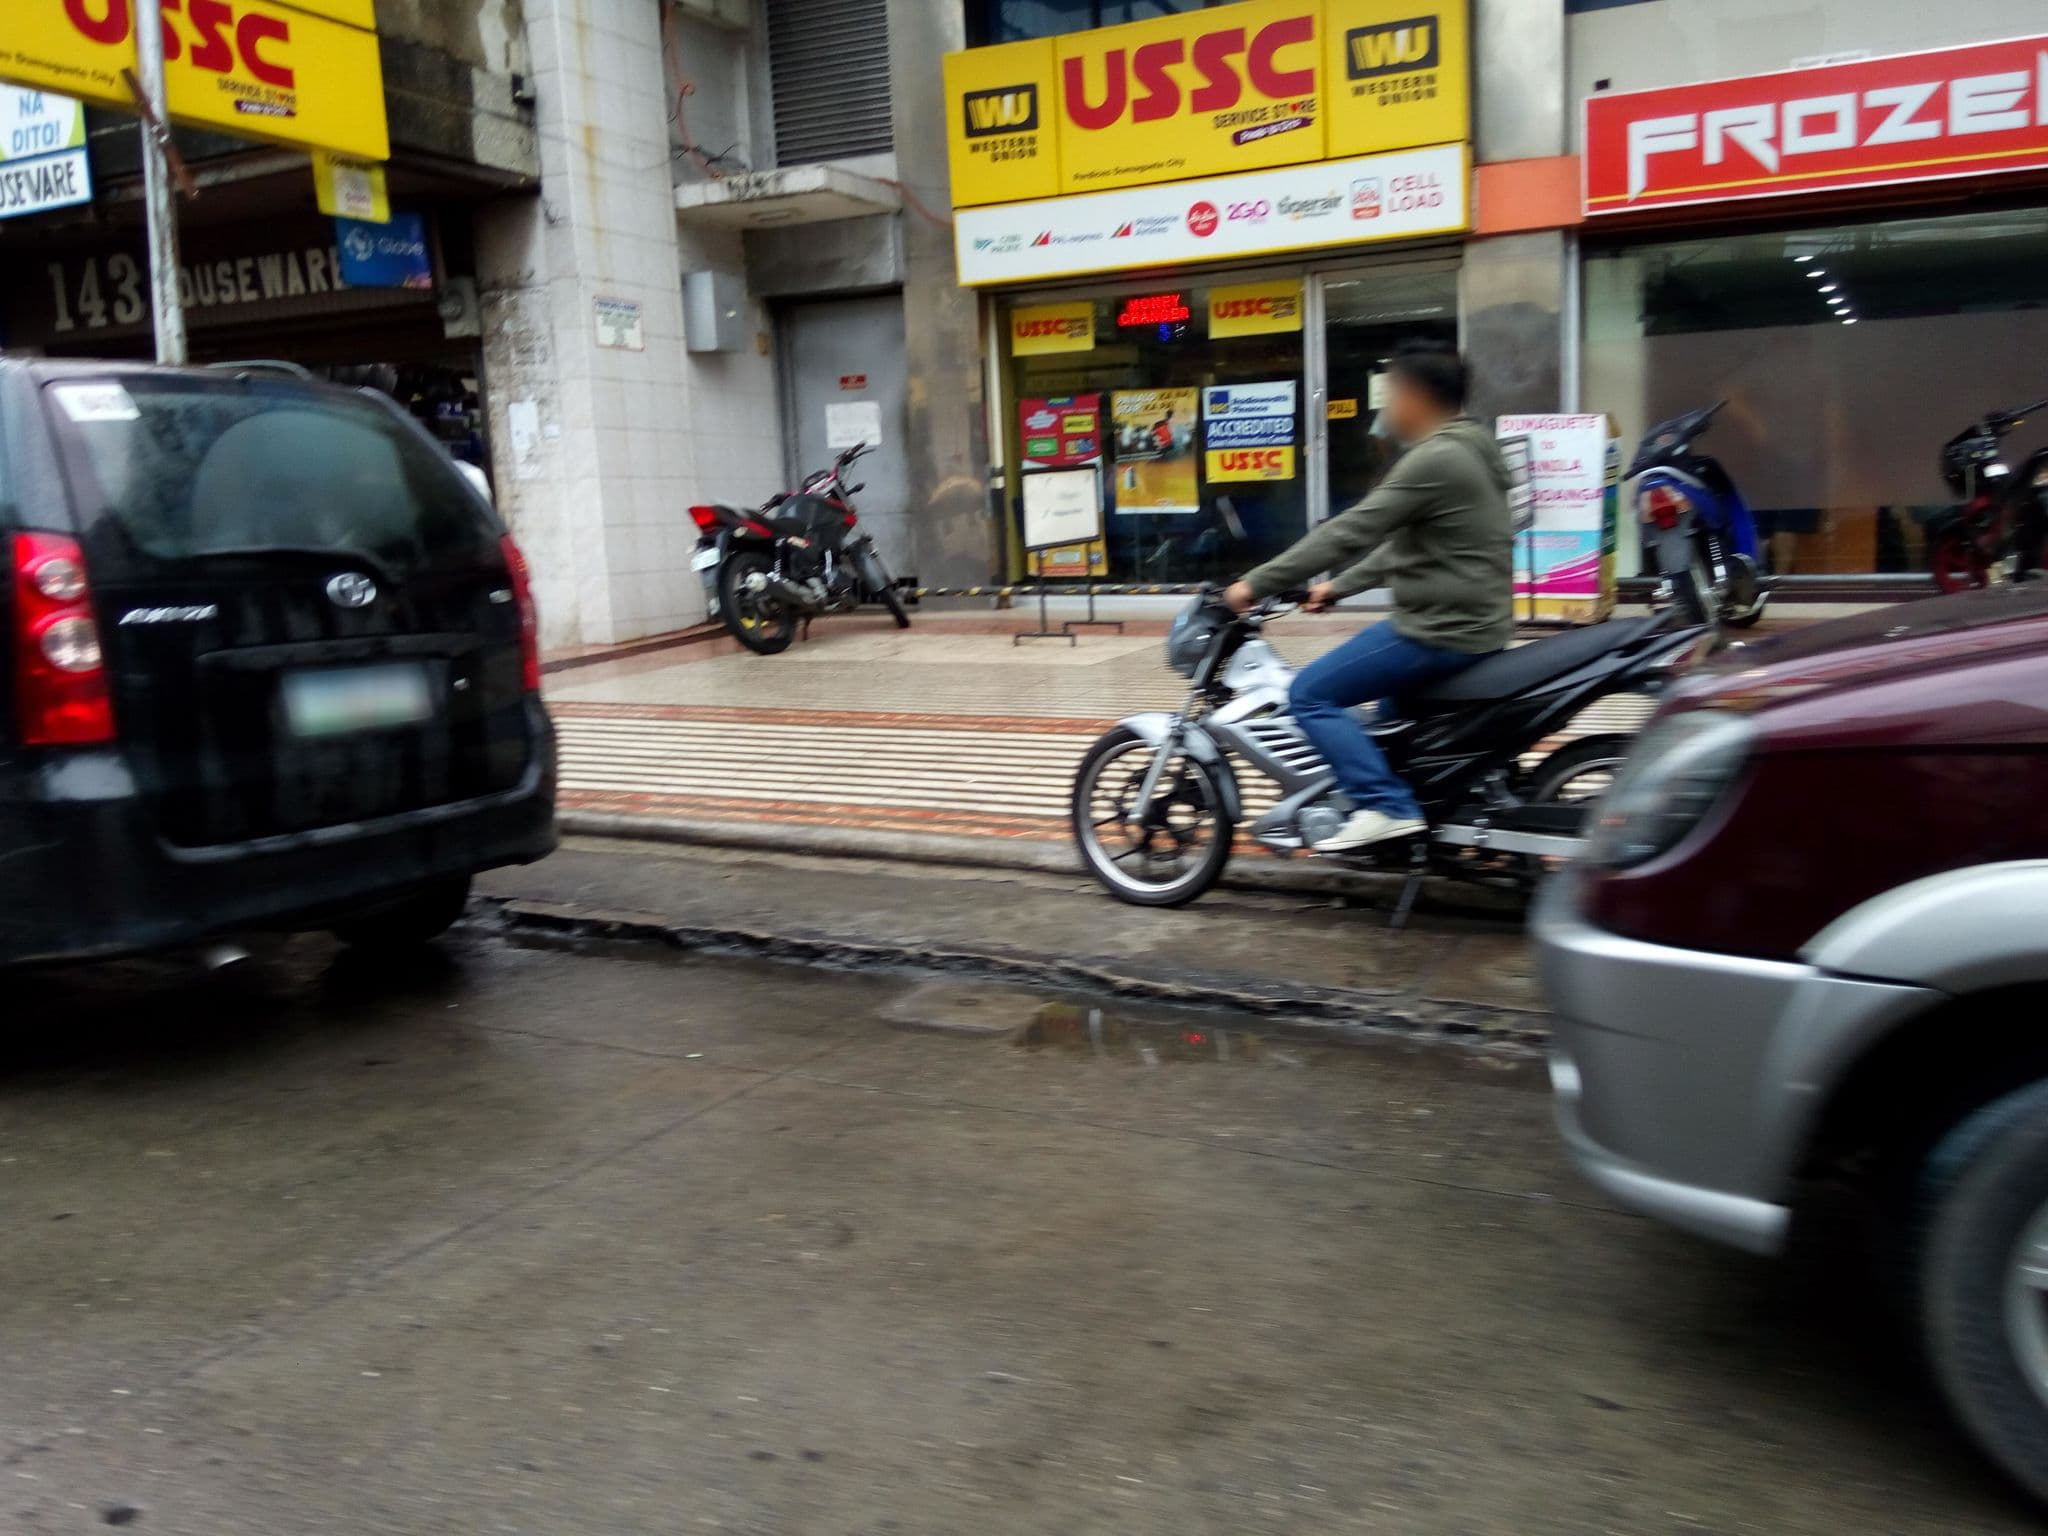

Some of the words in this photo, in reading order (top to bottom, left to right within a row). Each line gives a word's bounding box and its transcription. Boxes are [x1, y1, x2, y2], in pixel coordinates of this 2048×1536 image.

[1063, 15, 1315, 131] USSC
[1351, 74, 1438, 97] WESTERN
[19, 92, 44, 119] NA
[1378, 87, 1438, 107] UNION
[1213, 105, 1269, 129] SERVICE
[1628, 50, 2048, 204] FROZE
[11, 120, 61, 153] DITO!
[969, 136, 1037, 153] WESTERN
[990, 148, 1037, 163] UNION
[1389, 173, 1441, 193] CELL
[1226, 200, 1271, 221] 2GO
[1388, 191, 1446, 213] LOAD
[49, 253, 147, 333] 143
[178, 246, 345, 309] OUSEWARE
[1213, 297, 1270, 319] USSC
[1015, 319, 1068, 338] USSC
[1208, 417, 1294, 441] ACCREDITED
[1502, 415, 1597, 432] DUMAGUETE
[1220, 451, 1282, 472] USSC
[1529, 459, 1582, 473] ANILA
[1530, 487, 1604, 503] BOANGA
